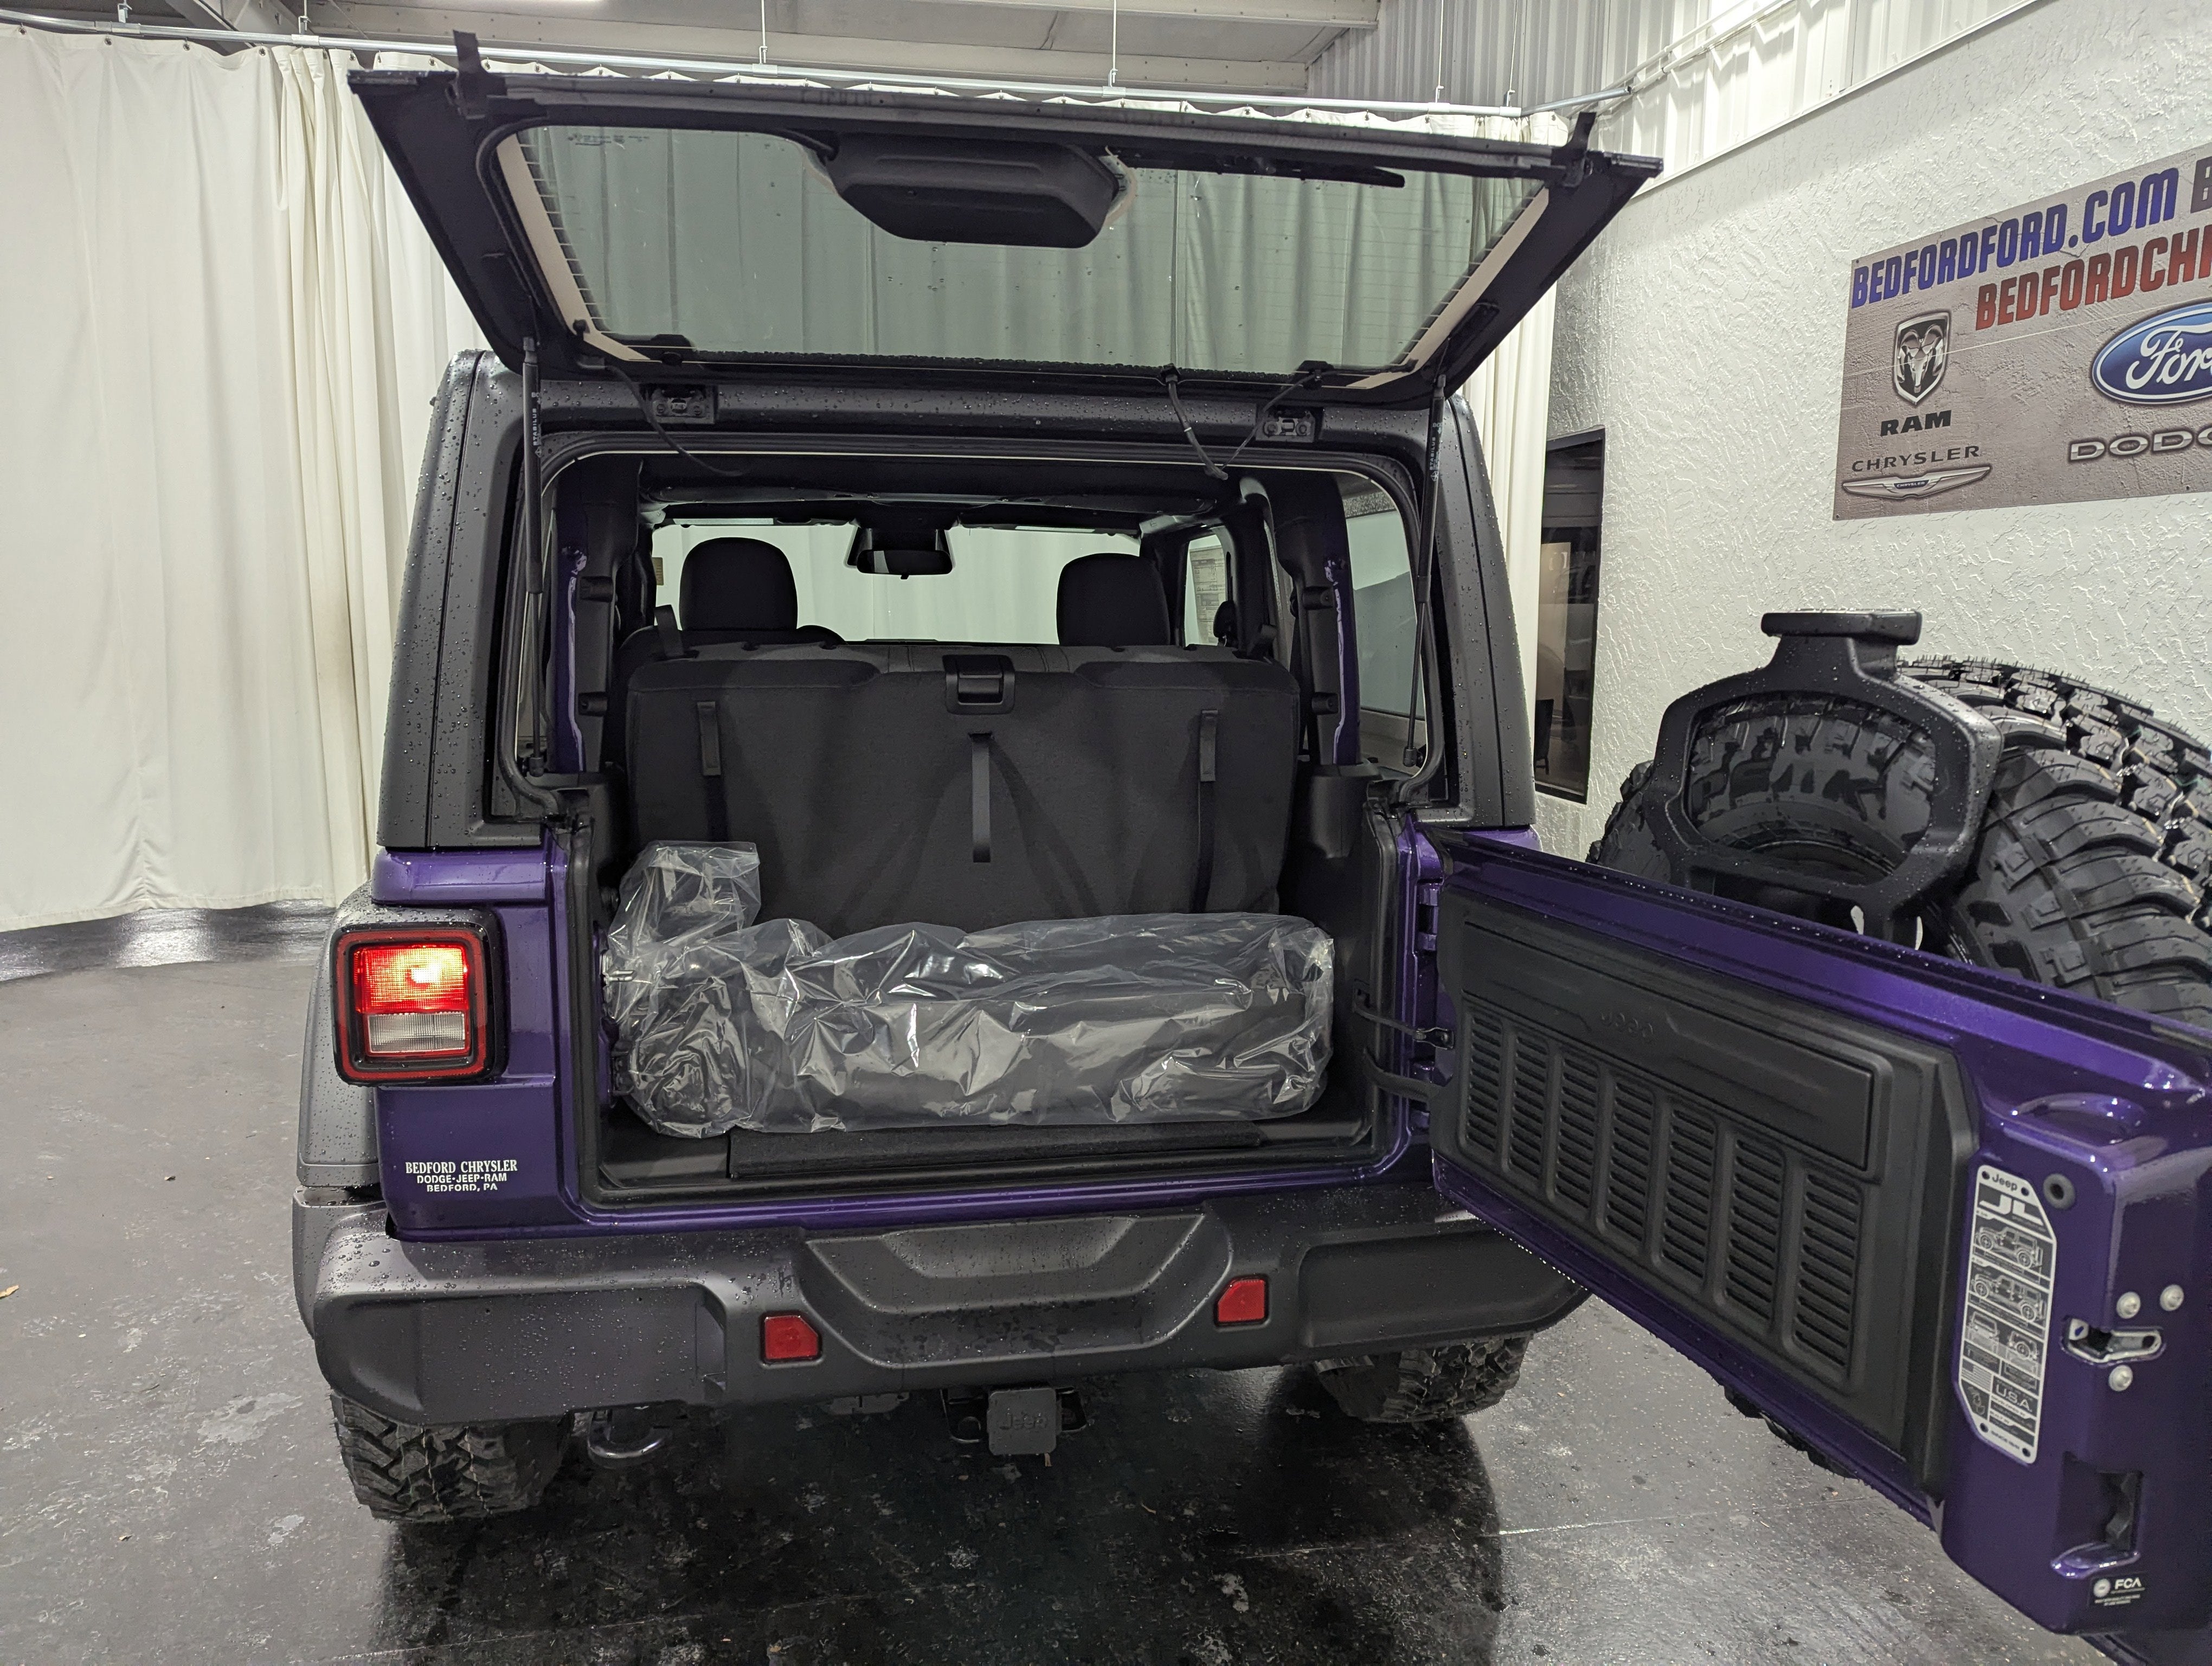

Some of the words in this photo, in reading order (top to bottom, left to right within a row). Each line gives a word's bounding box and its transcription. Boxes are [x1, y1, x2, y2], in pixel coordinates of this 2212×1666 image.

[1851, 167, 2179, 309] BEDFORDFORD.COM
[1881, 409, 1952, 437] RAM
[1852, 445, 1979, 472] CHRYSLER
[405, 1162, 456, 1174] BEDFORD
[460, 1159, 518, 1173] CHRYSLER
[427, 1184, 480, 1192] BEDFORD,
[1992, 1173, 2018, 1191] Jeep
[1979, 1194, 2044, 1227] JL
[1996, 1383, 2033, 1412] U.S.A.
[2115, 1577, 2142, 1590] FCA
